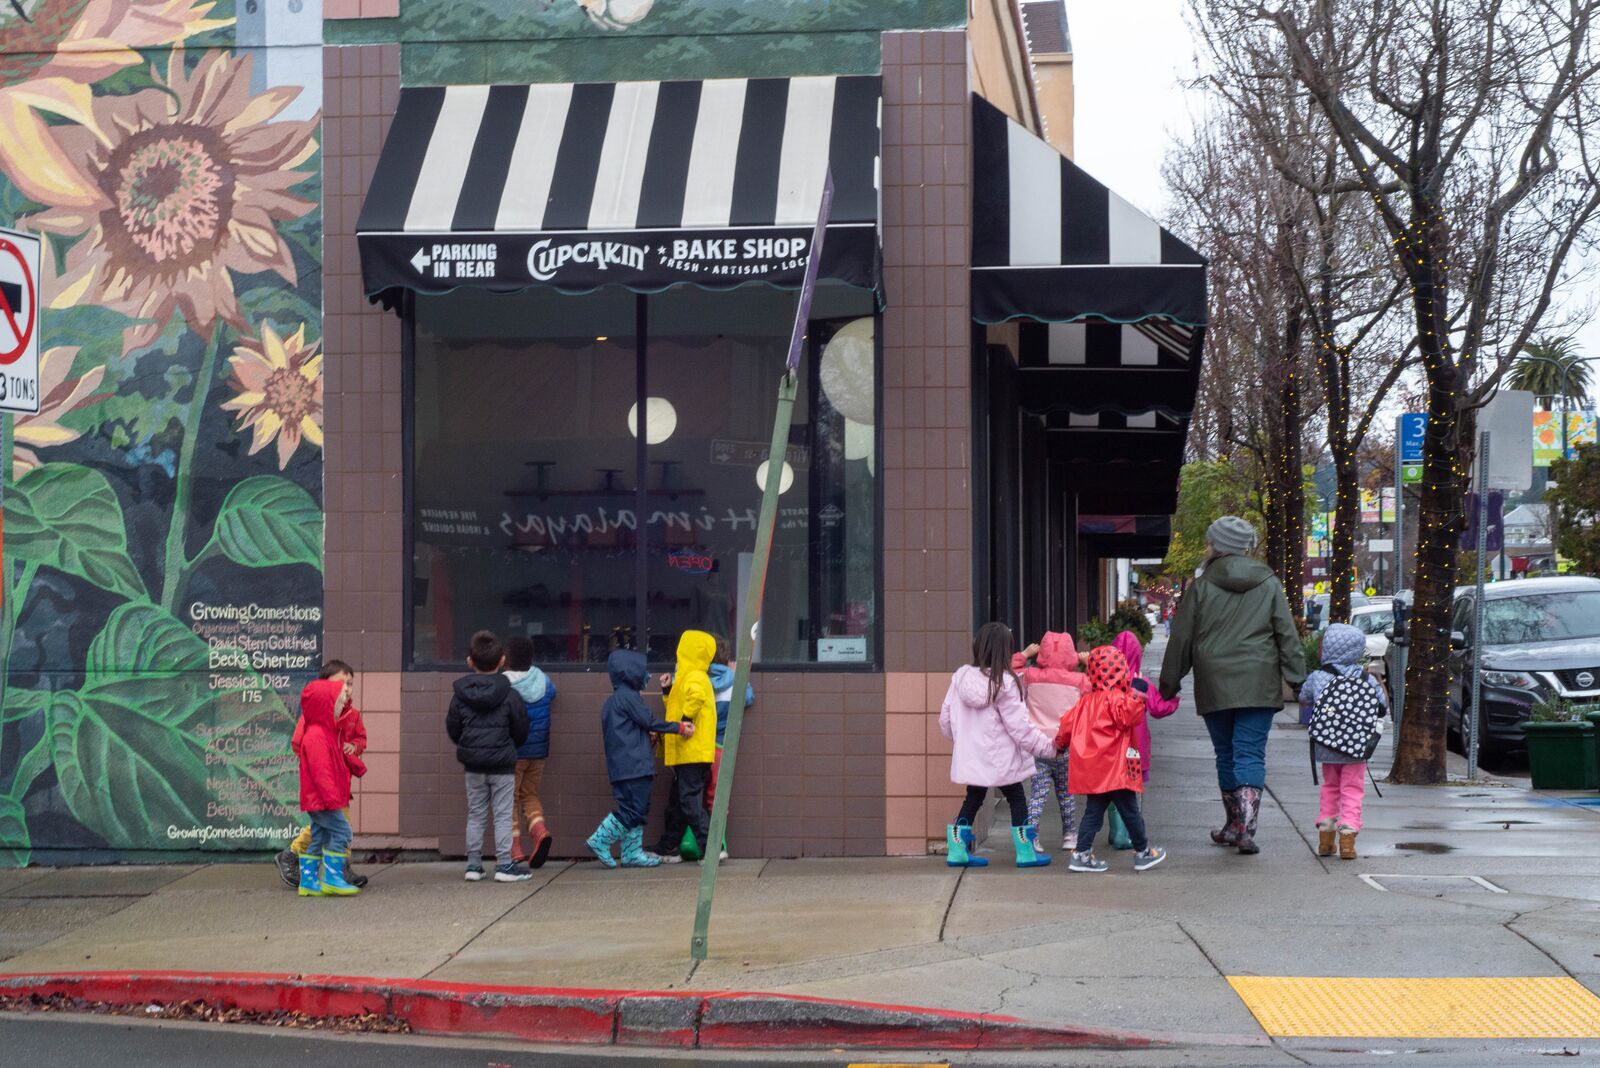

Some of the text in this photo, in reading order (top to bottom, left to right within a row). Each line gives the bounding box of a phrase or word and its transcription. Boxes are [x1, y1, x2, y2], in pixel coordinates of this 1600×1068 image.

[432, 244, 497, 260] PARKING
[673, 238, 806, 260] BAKE SHOP
[433, 261, 495, 278] IN REAR
[659, 256, 699, 273] FRESH
[712, 265, 768, 275] ARTISAN
[10, 376, 35, 400] TONS
[1412, 417, 1425, 437] 3
[208, 635, 237, 650] David
[208, 650, 312, 669] Becka Shertzer
[208, 673, 291, 690] Jessica Diaz
[242, 690, 263, 702] 175
